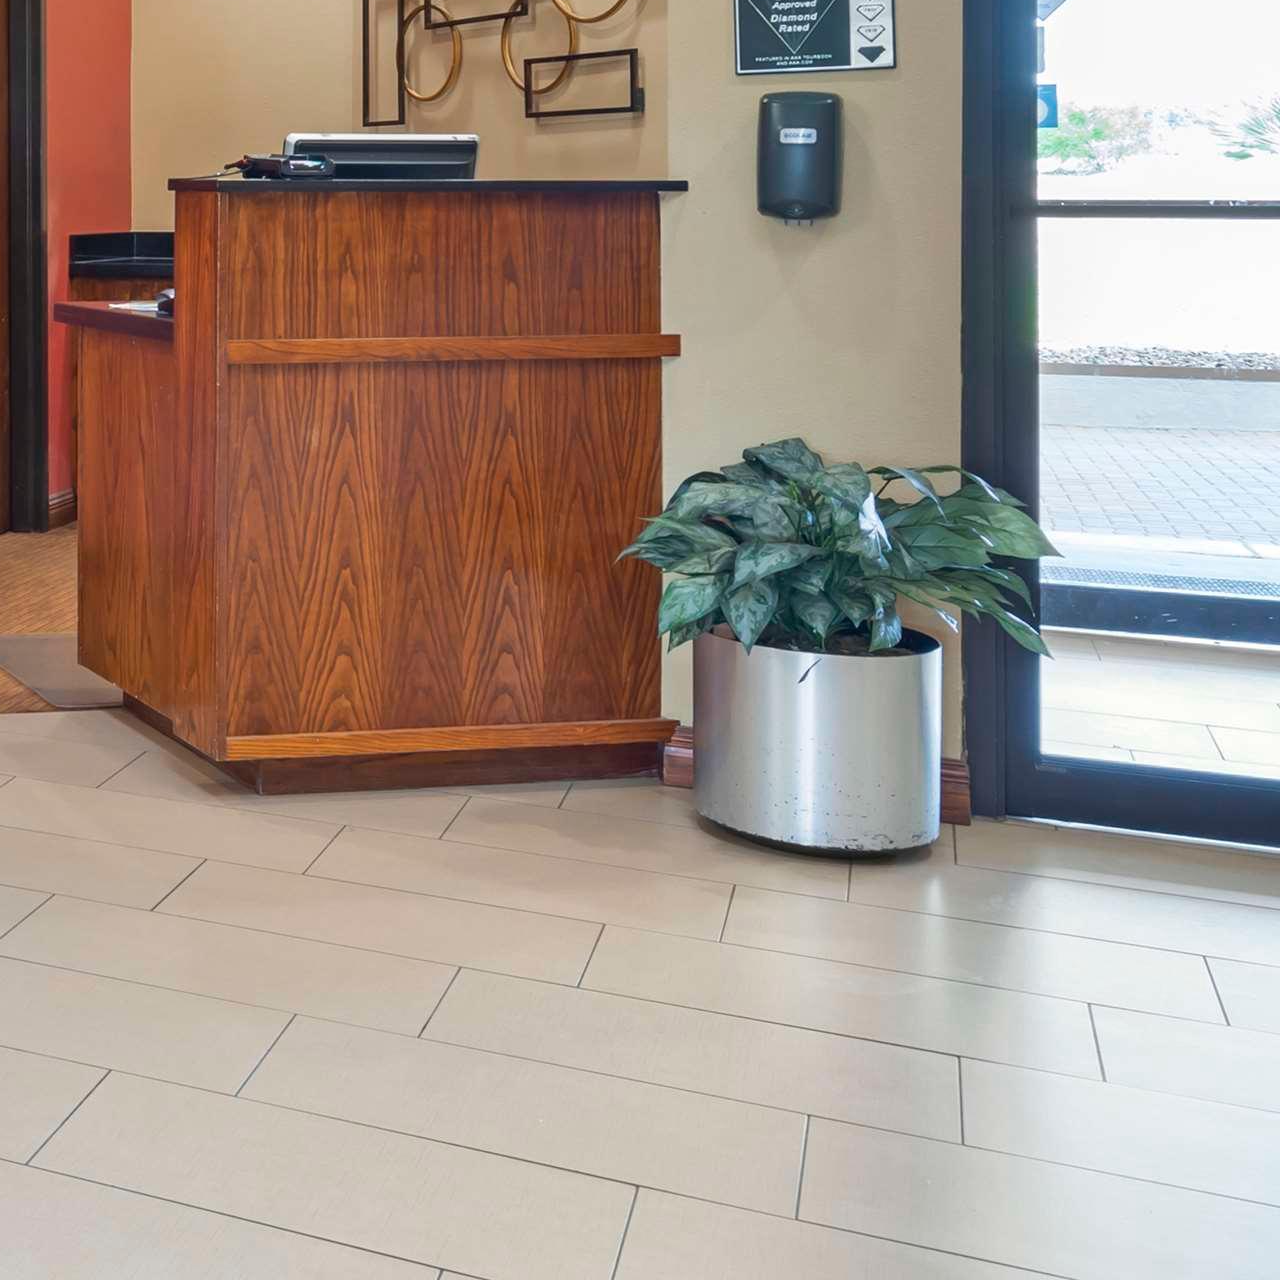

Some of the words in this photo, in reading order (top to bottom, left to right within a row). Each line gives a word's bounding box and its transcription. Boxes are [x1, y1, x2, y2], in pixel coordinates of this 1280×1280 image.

[772, 0, 818, 10] Approved
[770, 13, 818, 23] Diamond
[778, 23, 811, 33] Rated
